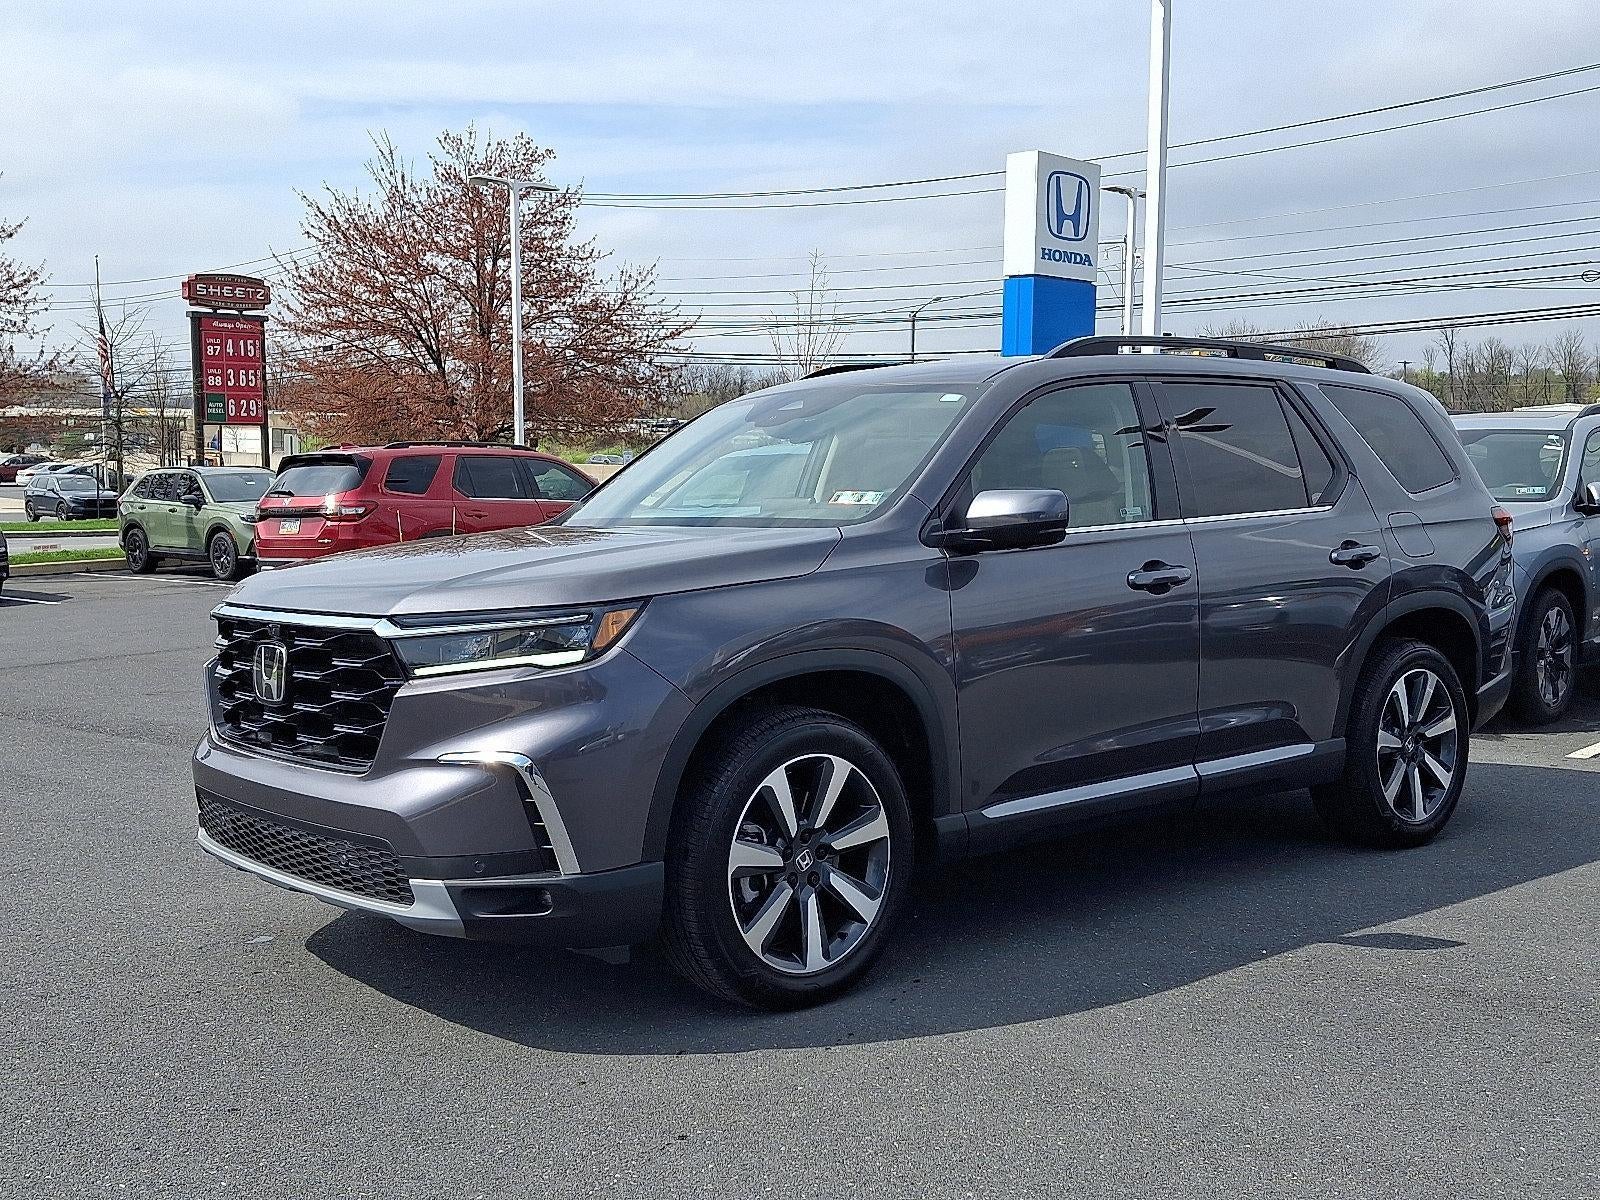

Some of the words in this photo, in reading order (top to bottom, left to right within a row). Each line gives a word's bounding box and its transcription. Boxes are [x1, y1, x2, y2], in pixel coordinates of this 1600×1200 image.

[1040, 247, 1093, 267] HONDA
[196, 284, 265, 300] SHEETZ
[212, 320, 234, 331] Always
[235, 322, 252, 330] Open
[206, 345, 221, 356] 87
[226, 338, 255, 357] 4.15
[207, 375, 222, 386] 88
[226, 368, 256, 387] 3.65
[228, 398, 257, 417] 6.29
